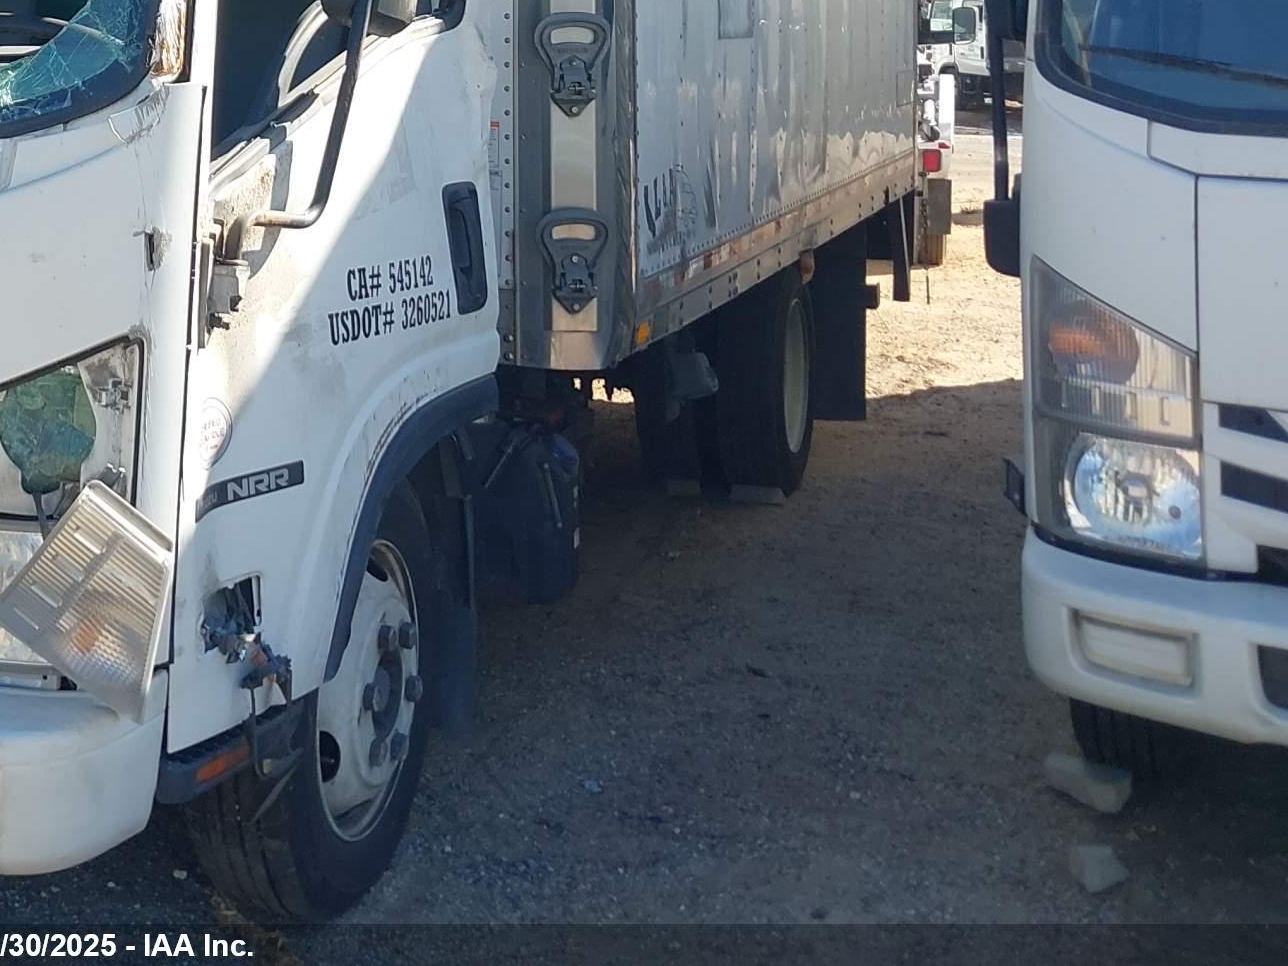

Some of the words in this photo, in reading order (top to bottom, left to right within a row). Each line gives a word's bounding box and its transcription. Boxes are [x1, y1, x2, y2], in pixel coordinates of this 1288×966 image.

[346, 265, 382, 301] CA#
[388, 255, 434, 294] 545142
[328, 301, 395, 346] USDOT#
[401, 289, 451, 330] 3260521
[227, 467, 289, 501] NRR
